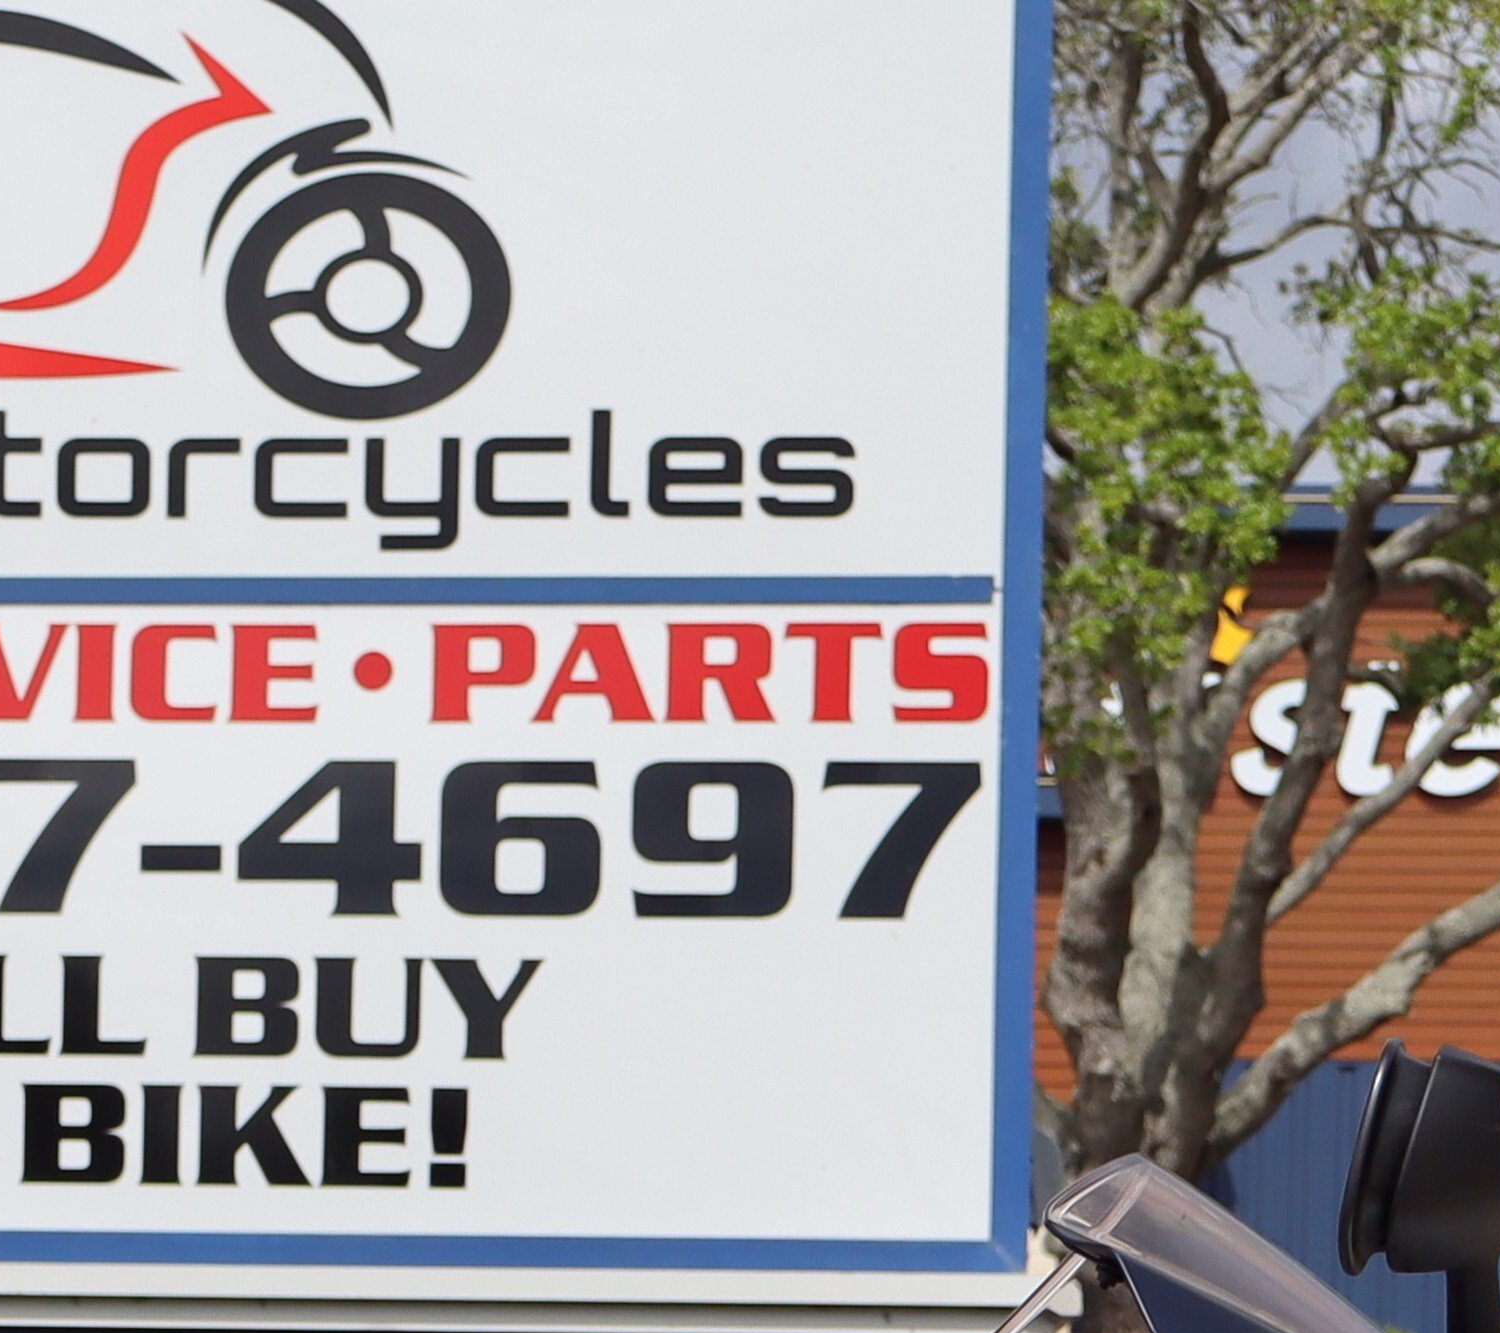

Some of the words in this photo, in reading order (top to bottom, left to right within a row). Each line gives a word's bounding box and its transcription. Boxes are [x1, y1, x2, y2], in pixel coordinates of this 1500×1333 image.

[433, 622, 989, 723] PARTS
[195, 957, 542, 1059] BUY
[22, 1085, 468, 1188] BIKE!
